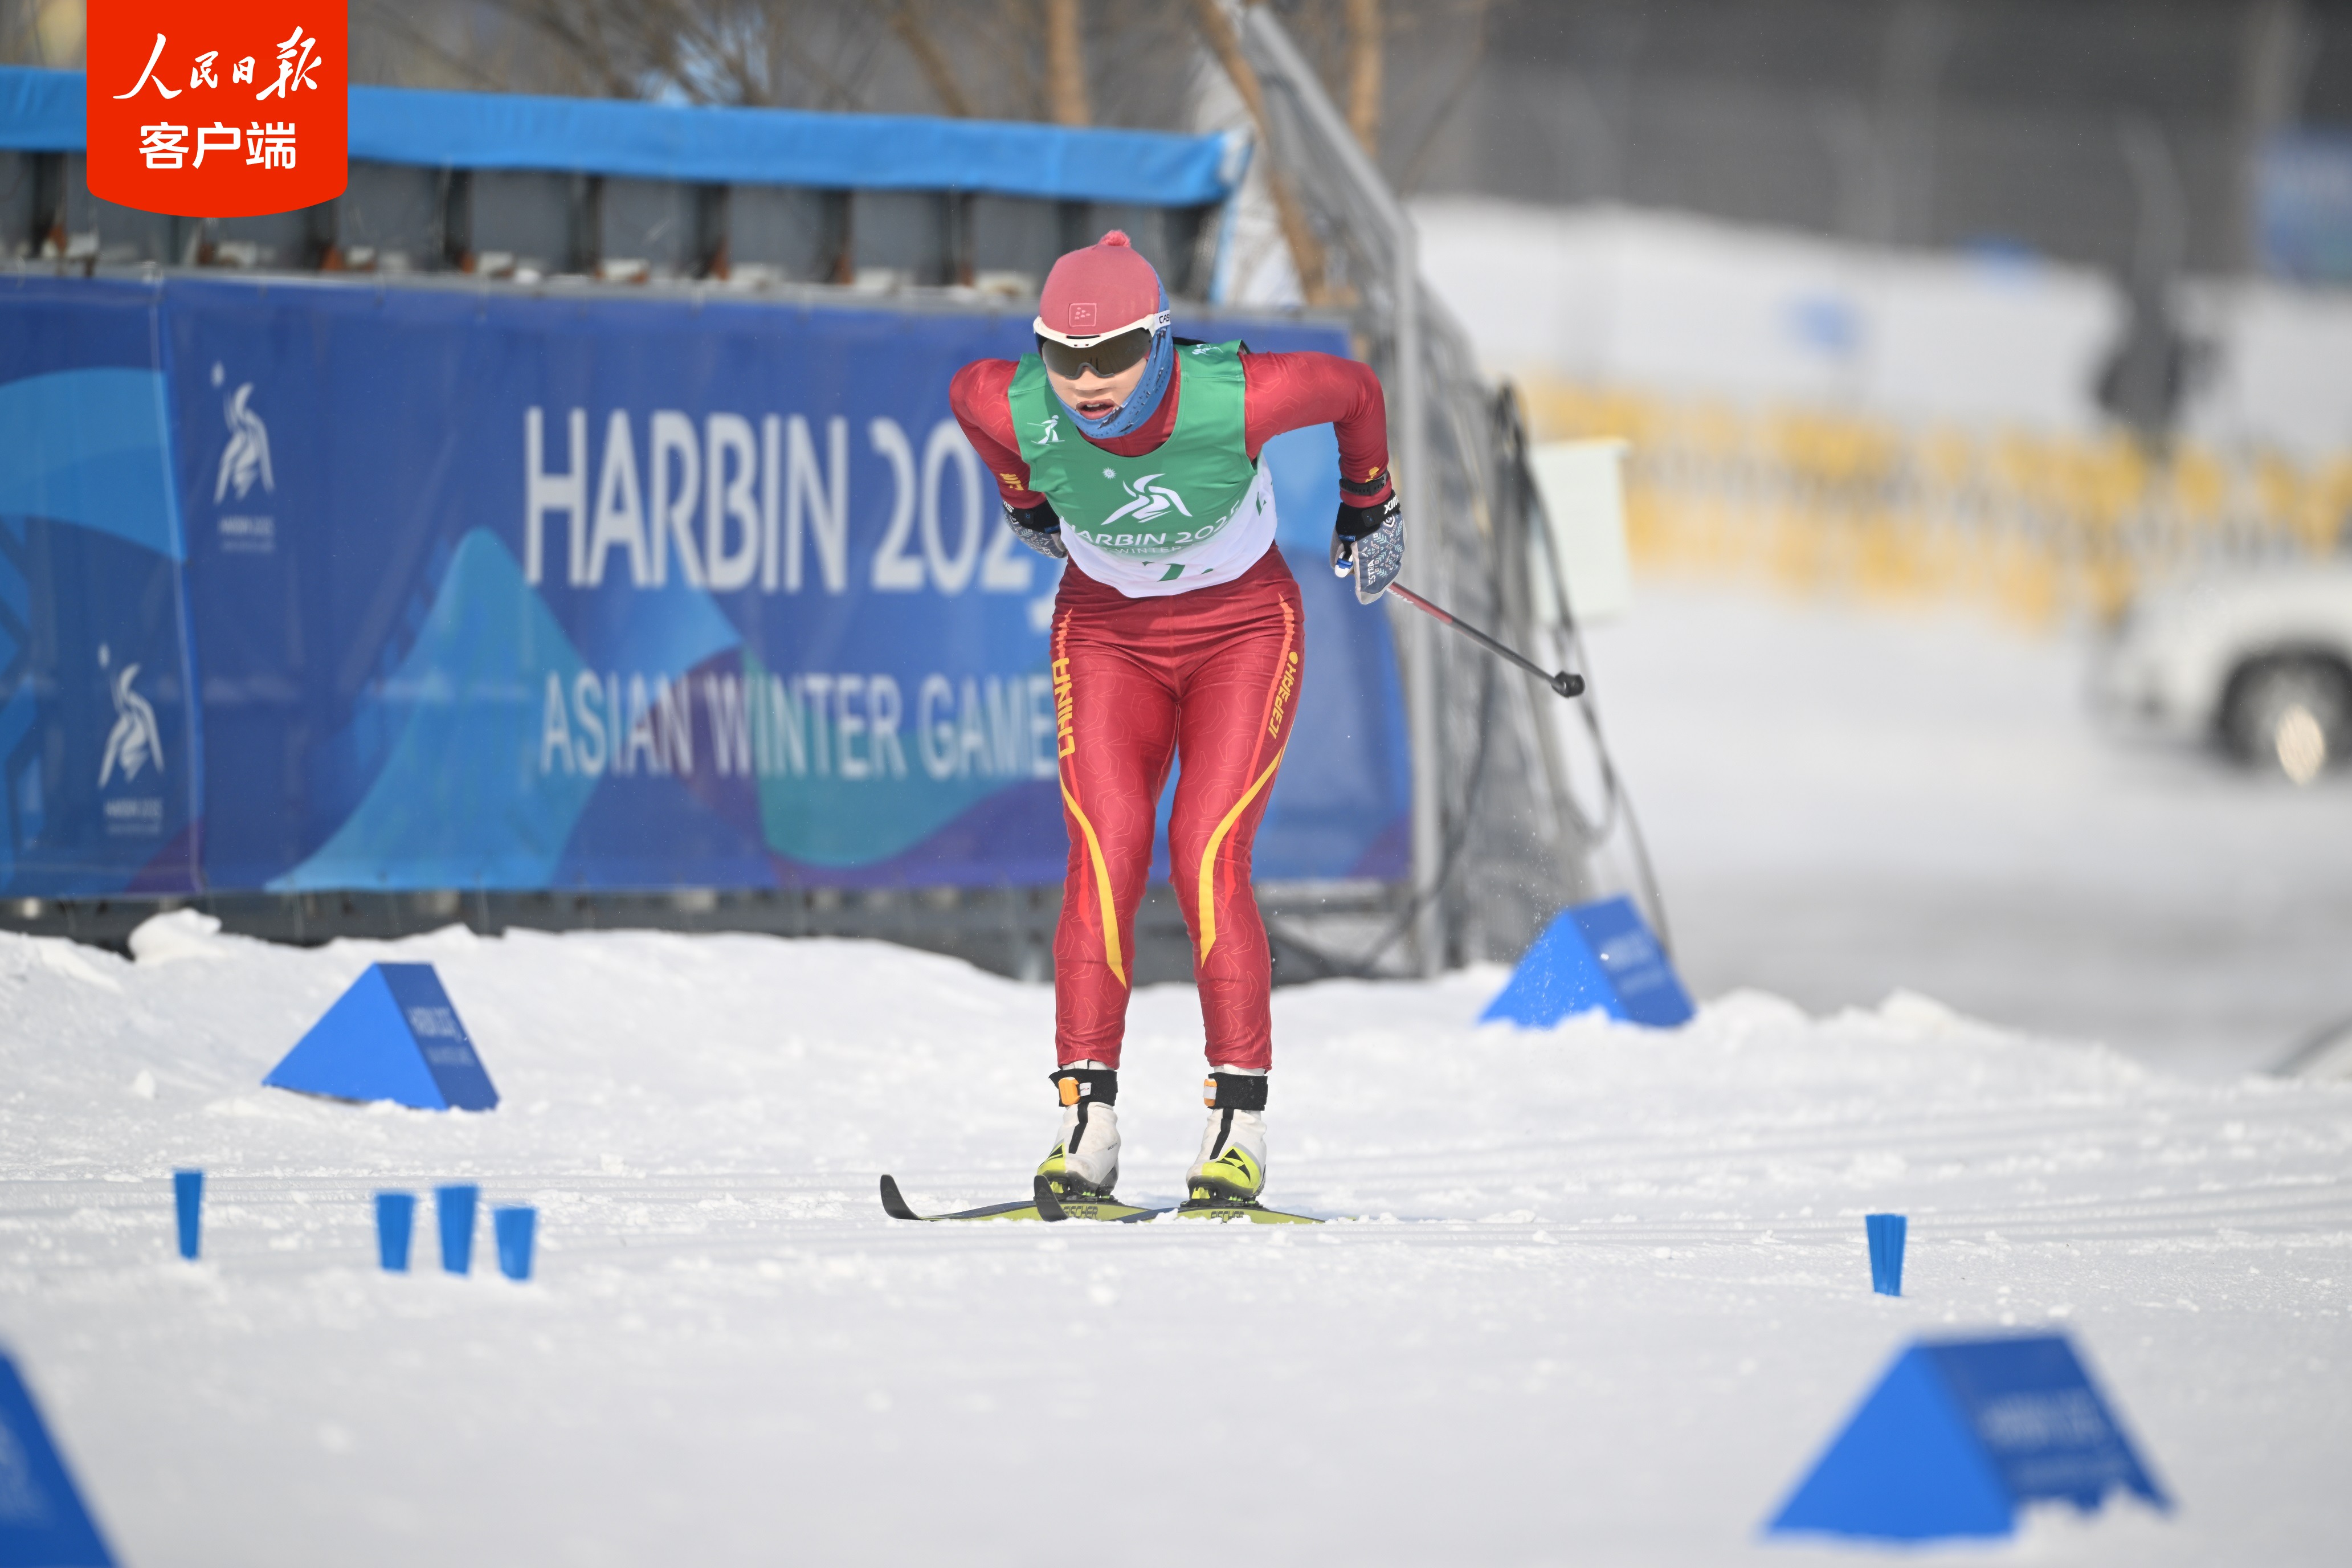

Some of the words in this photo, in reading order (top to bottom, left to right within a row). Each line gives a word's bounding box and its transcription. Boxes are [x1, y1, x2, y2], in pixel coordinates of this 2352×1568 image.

[524, 406, 850, 595] HARBIN
[869, 415, 1054, 634] 202
[540, 669, 692, 778] ASIAN
[707, 669, 907, 779] WINTER
[918, 671, 1059, 779] GAME
[1052, 658, 1076, 760] CHINA
